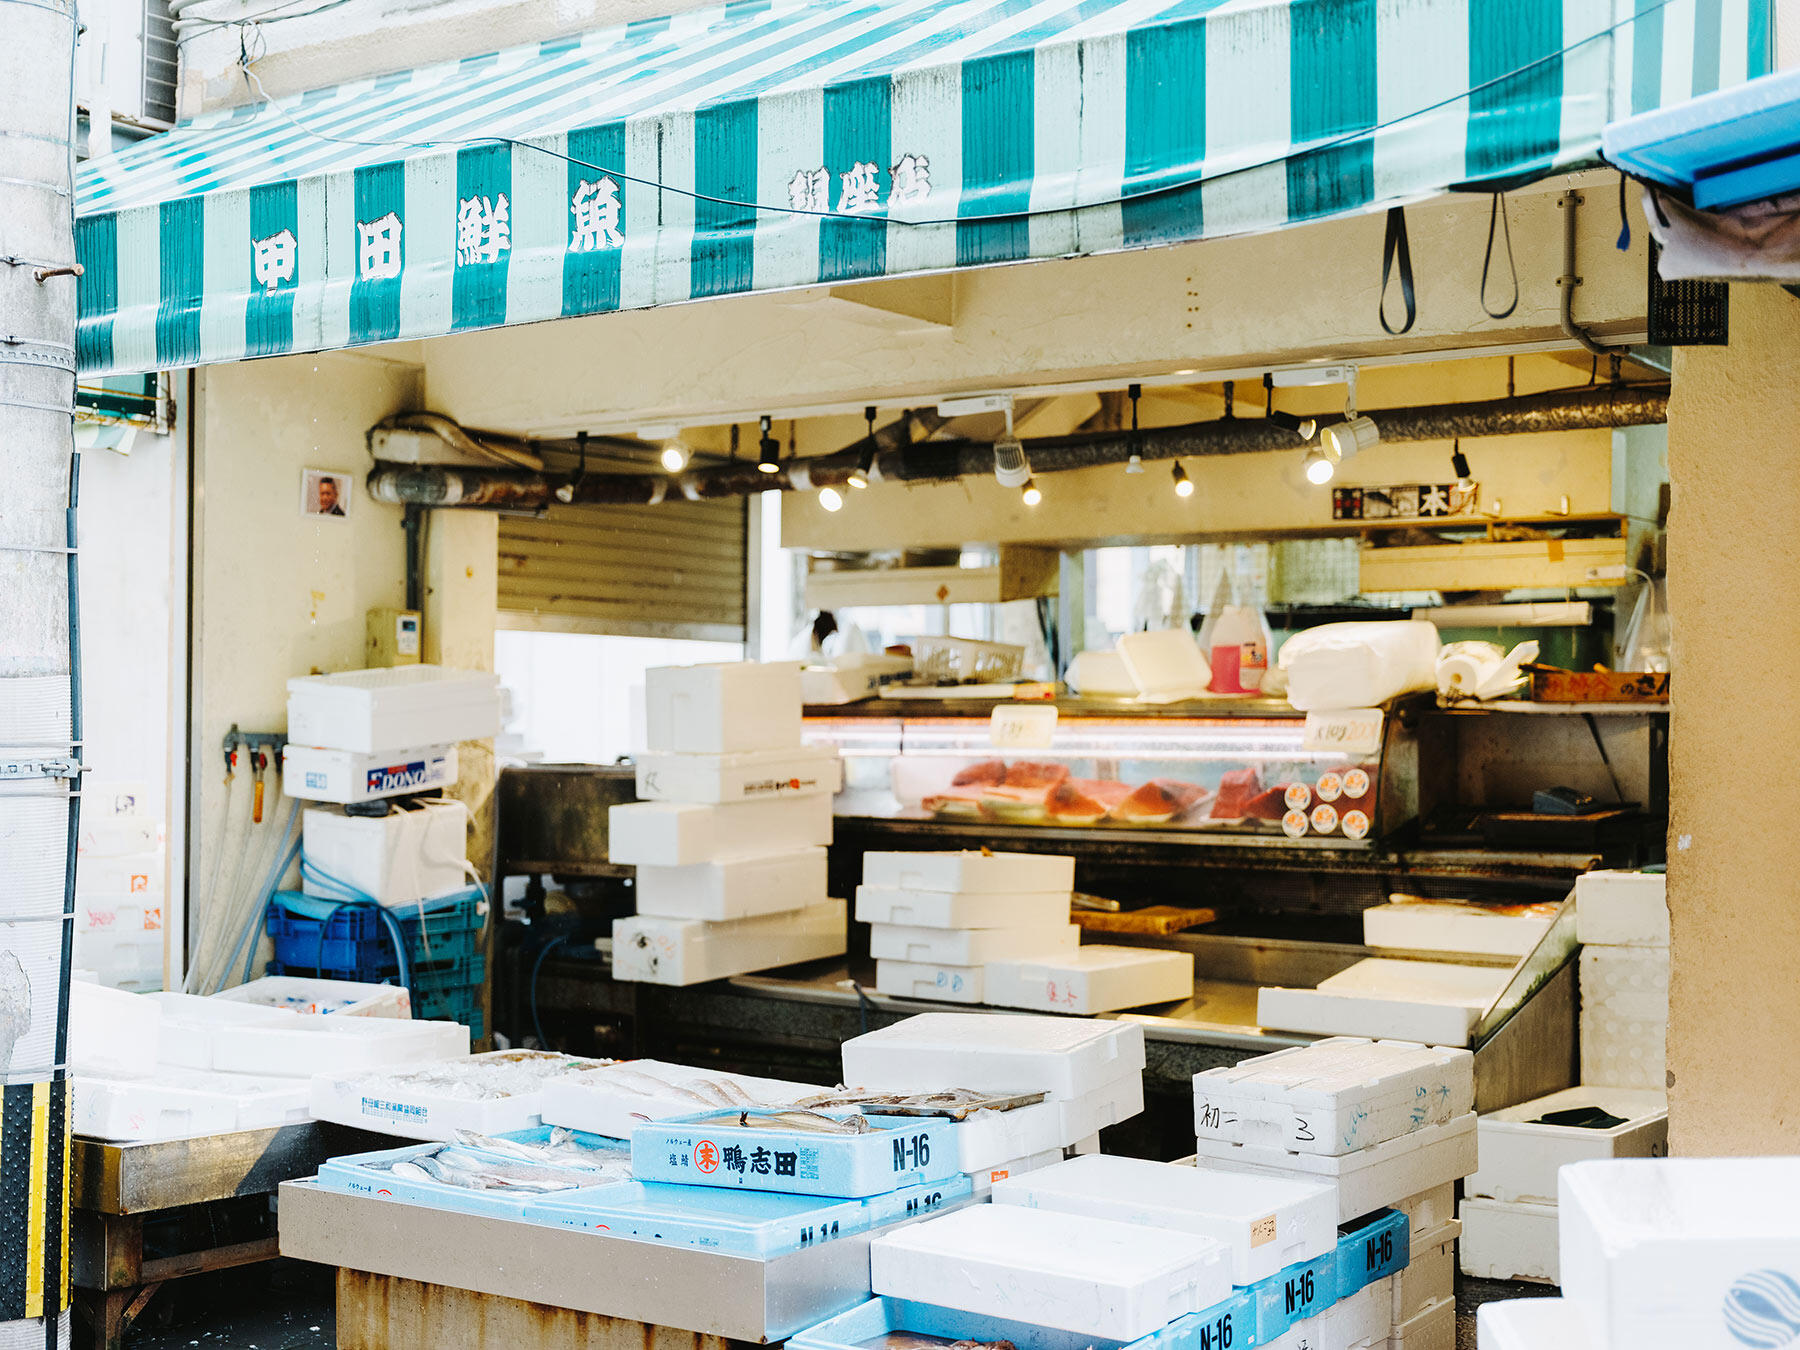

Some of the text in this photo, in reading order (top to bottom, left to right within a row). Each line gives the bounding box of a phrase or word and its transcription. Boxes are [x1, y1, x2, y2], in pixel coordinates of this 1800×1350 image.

[252, 175, 625, 296] 甲田鮮魚
[1295, 1117, 1315, 1141] 3
[723, 1144, 798, 1177] 鴨志田
[893, 1133, 930, 1172] N-16
[1366, 1230, 1393, 1271] N-16
[1285, 1269, 1314, 1315] N-16
[1200, 1313, 1233, 1350] N-16
